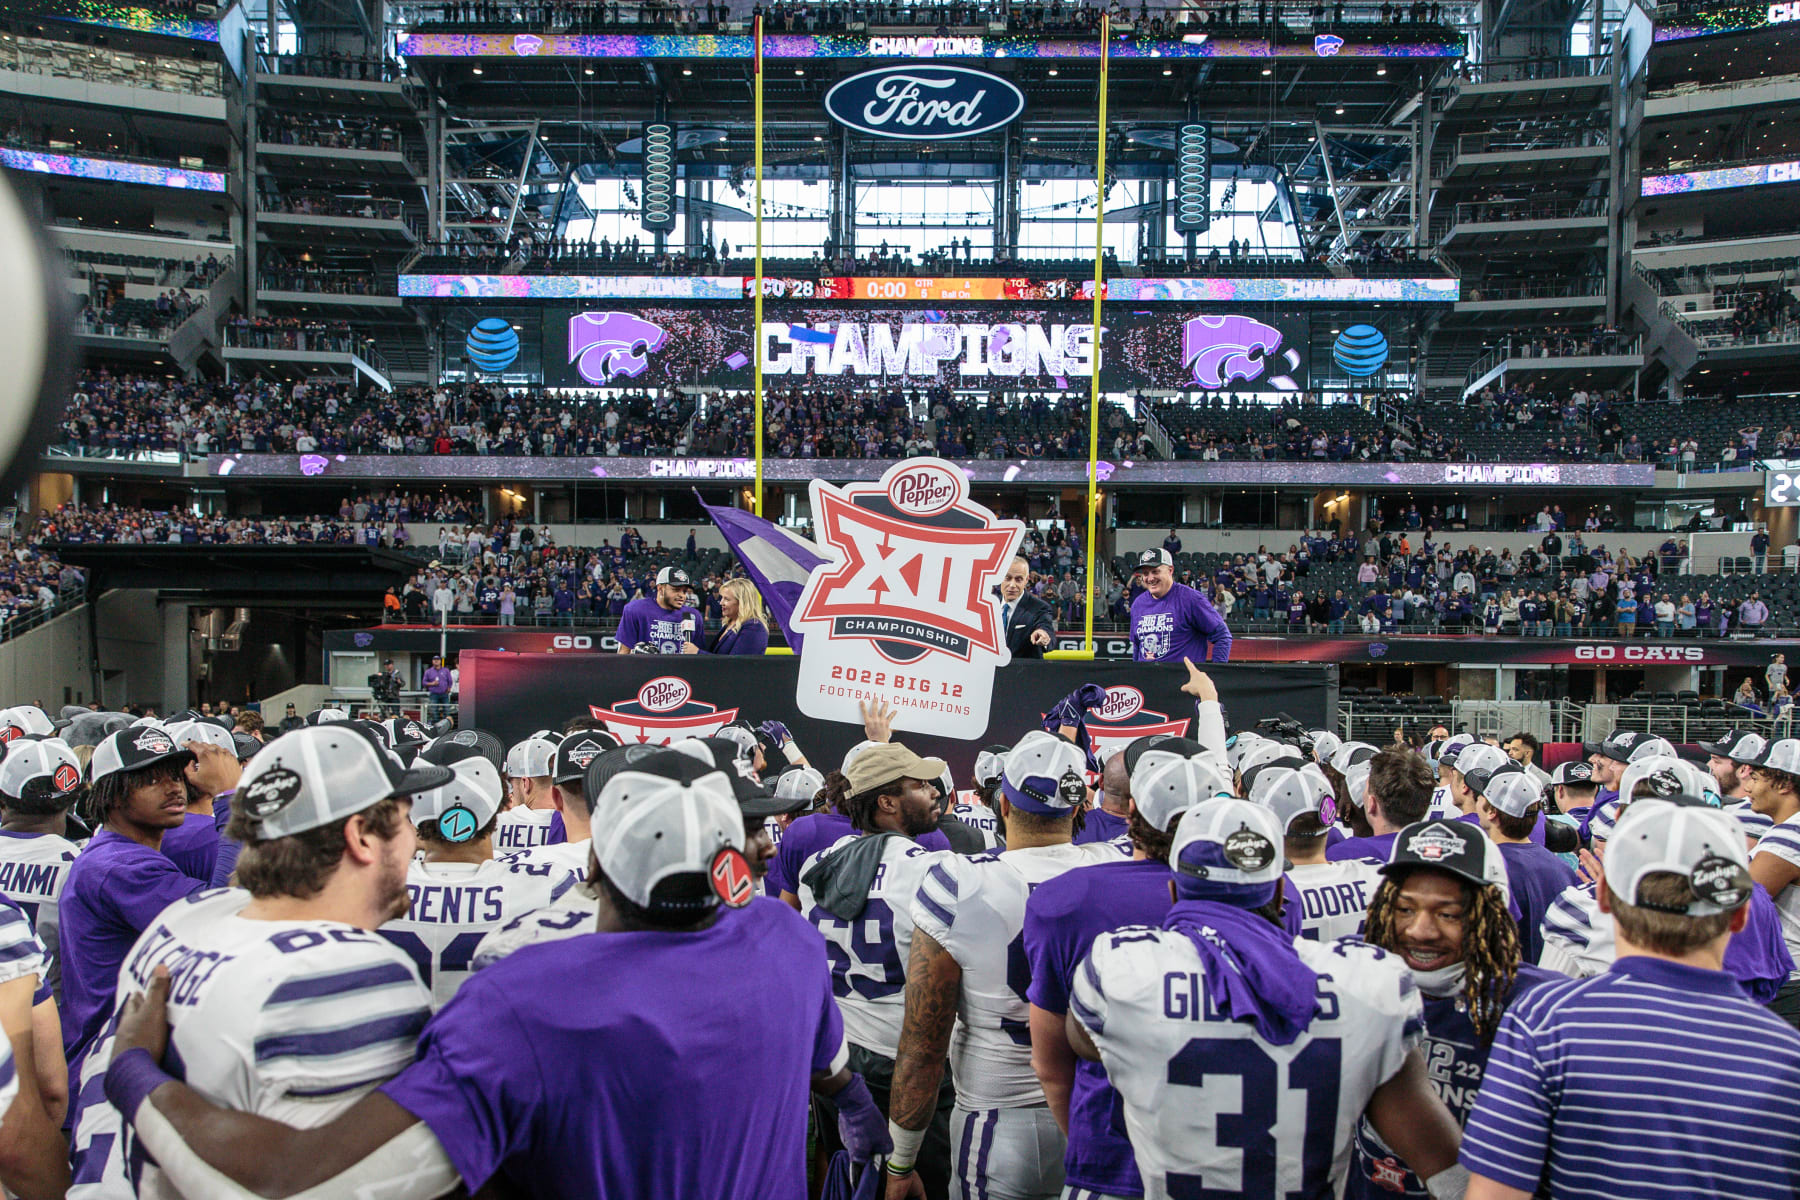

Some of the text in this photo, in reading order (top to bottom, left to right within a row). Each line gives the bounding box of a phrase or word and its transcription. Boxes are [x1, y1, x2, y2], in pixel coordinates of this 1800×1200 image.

[870, 37, 983, 55] CHAMPIONS
[864, 75, 986, 126] Ford
[746, 278, 786, 298] TCU
[792, 281, 814, 298] 28
[820, 279, 837, 287] TOL
[867, 282, 906, 298] 0:00
[915, 279, 933, 287] QTR
[1010, 279, 1028, 288] TOL
[1046, 282, 1067, 298] 31
[824, 288, 831, 297] 0
[942, 290, 970, 299] Ball On
[754, 322, 1103, 376] CHAMPIONS
[916, 473, 938, 490] Dr
[1445, 464, 1560, 482] CHAMPIONS
[893, 475, 951, 507] Pepper
[824, 513, 997, 633] XII
[553, 635, 593, 649] GO
[650, 632, 686, 641] CHAMPION
[845, 619, 960, 647] CHAMPIONSHIP
[1575, 645, 1704, 661] GO CATS
[657, 682, 674, 693] Dr
[831, 665, 964, 698] 2022 BIG 12
[647, 685, 685, 706] Pepper
[819, 684, 971, 716] FOOTBALL CHAMPIONS
[1110, 692, 1127, 703] Dr
[0, 862, 59, 896] ANMI
[405, 885, 504, 924] RENTS
[1302, 880, 1367, 921] OORE
[1455, 1061, 1482, 1080] 22
[1165, 1037, 1343, 1200] 31
